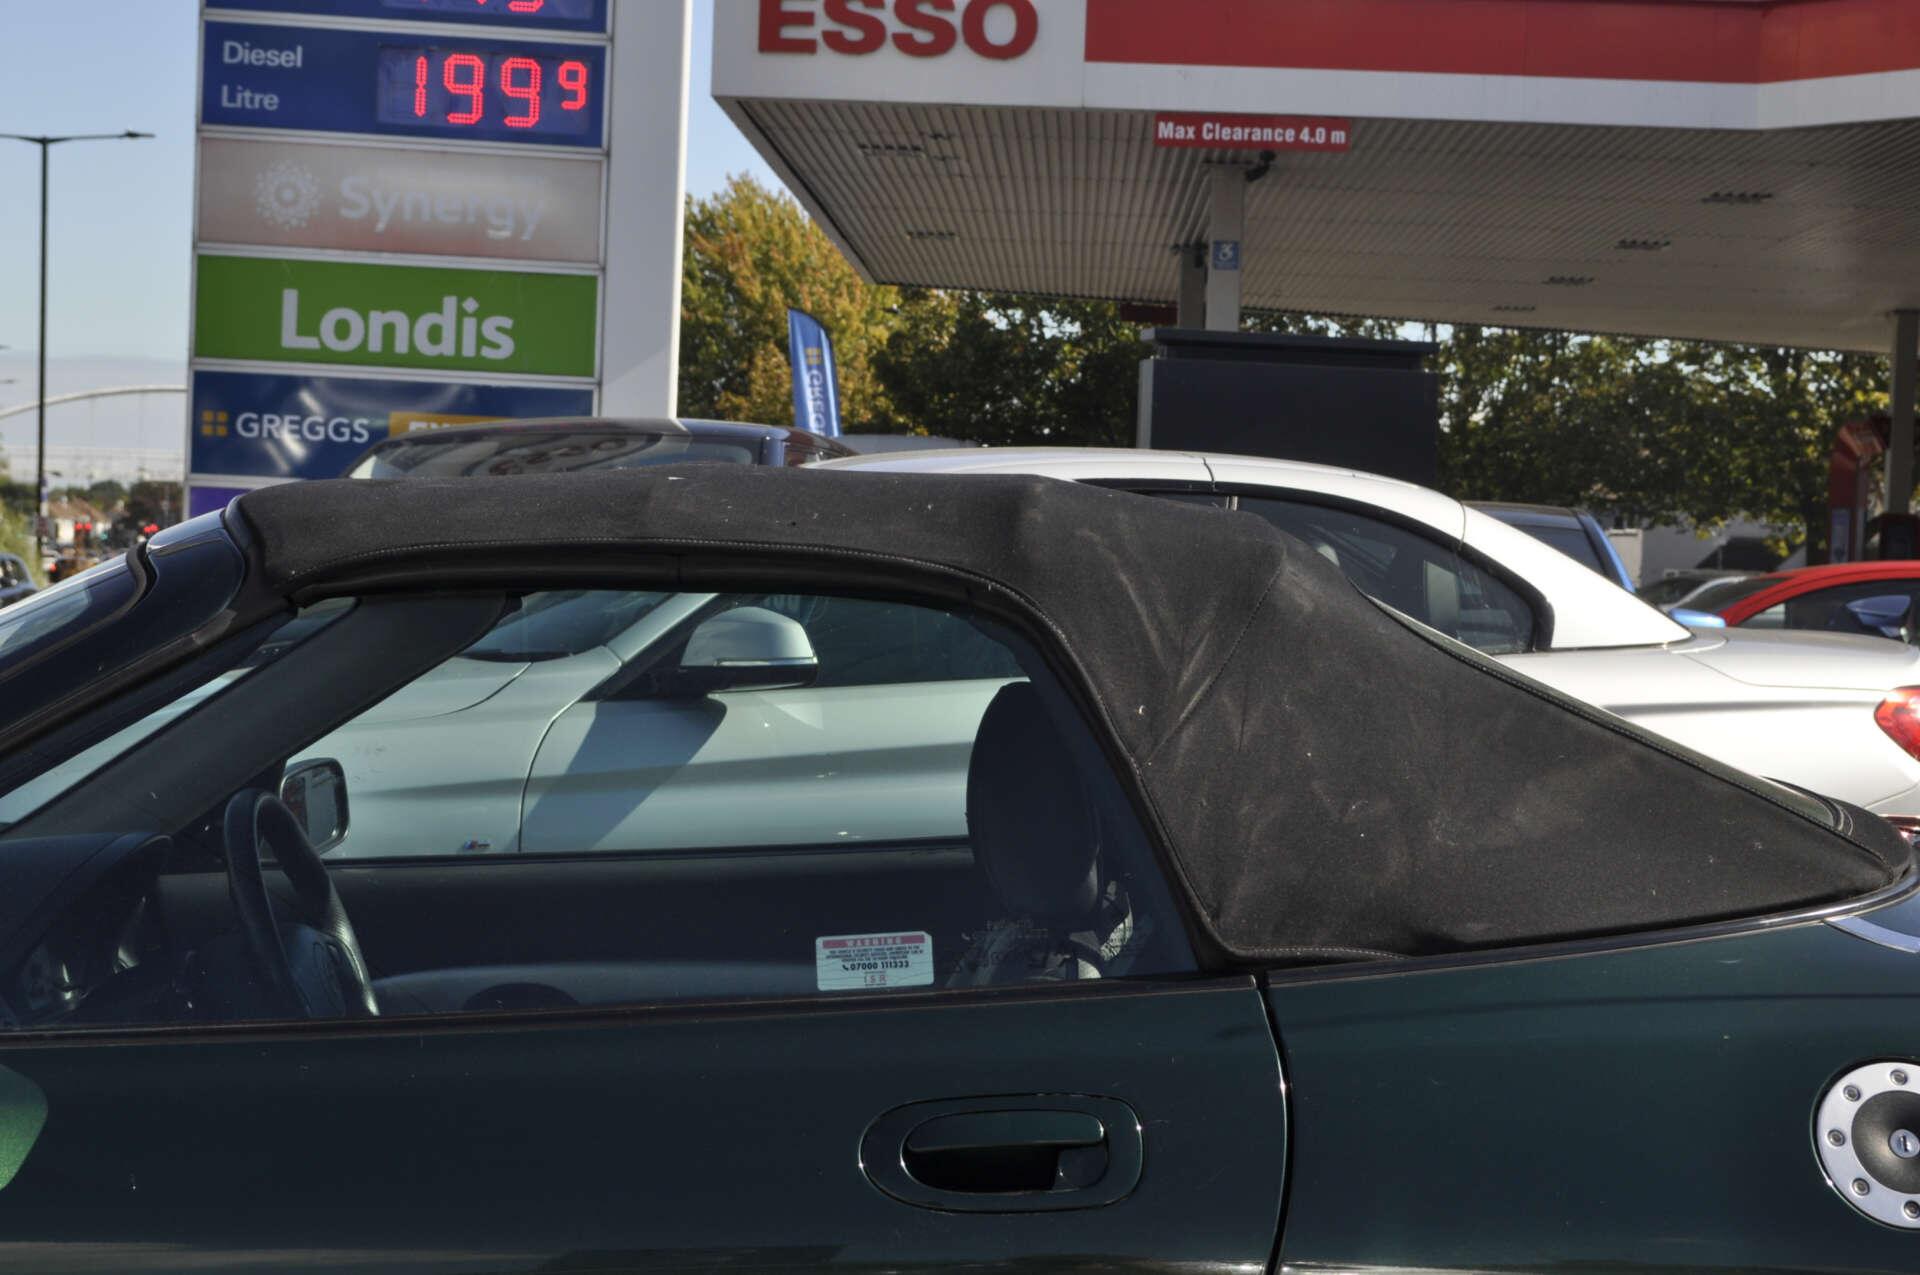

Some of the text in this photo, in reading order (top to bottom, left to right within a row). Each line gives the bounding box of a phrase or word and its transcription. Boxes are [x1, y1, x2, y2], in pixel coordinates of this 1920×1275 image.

[758, 0, 1039, 60] ESSO
[223, 40, 303, 68] Diesel
[221, 84, 280, 111] Litre
[1158, 121, 1195, 140] Max
[1202, 122, 1295, 143] Clearance
[339, 174, 546, 241] Synergy
[281, 288, 515, 360] Londis
[235, 411, 371, 443] GREGGS
[850, 961, 879, 971] 07000
